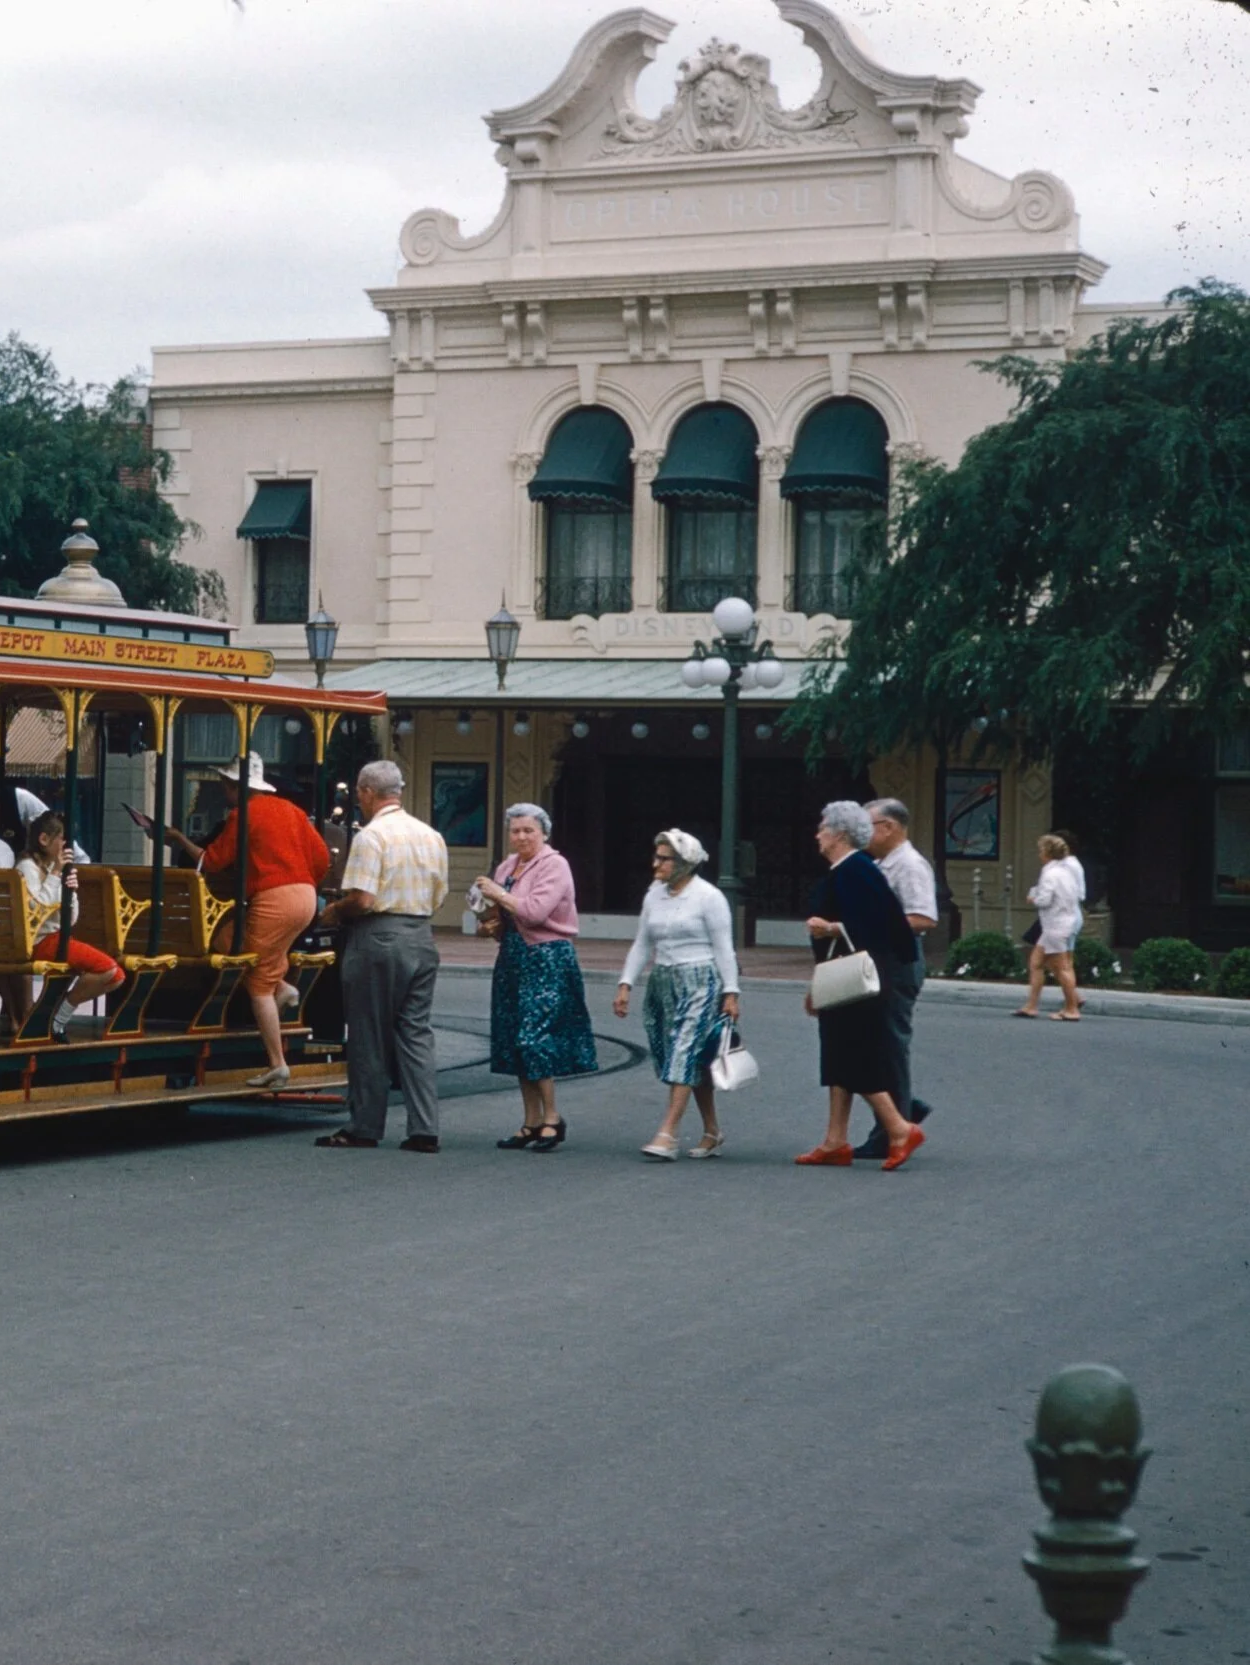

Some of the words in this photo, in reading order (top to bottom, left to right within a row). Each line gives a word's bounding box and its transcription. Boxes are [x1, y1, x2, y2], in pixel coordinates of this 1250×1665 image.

[564, 192, 703, 228] OPERA
[727, 181, 873, 219] HOUSE
[615, 616, 795, 638] DISNEYND
[64, 637, 106, 657] MAIN
[114, 644, 177, 664] STREET
[196, 650, 246, 670] PLAZA
